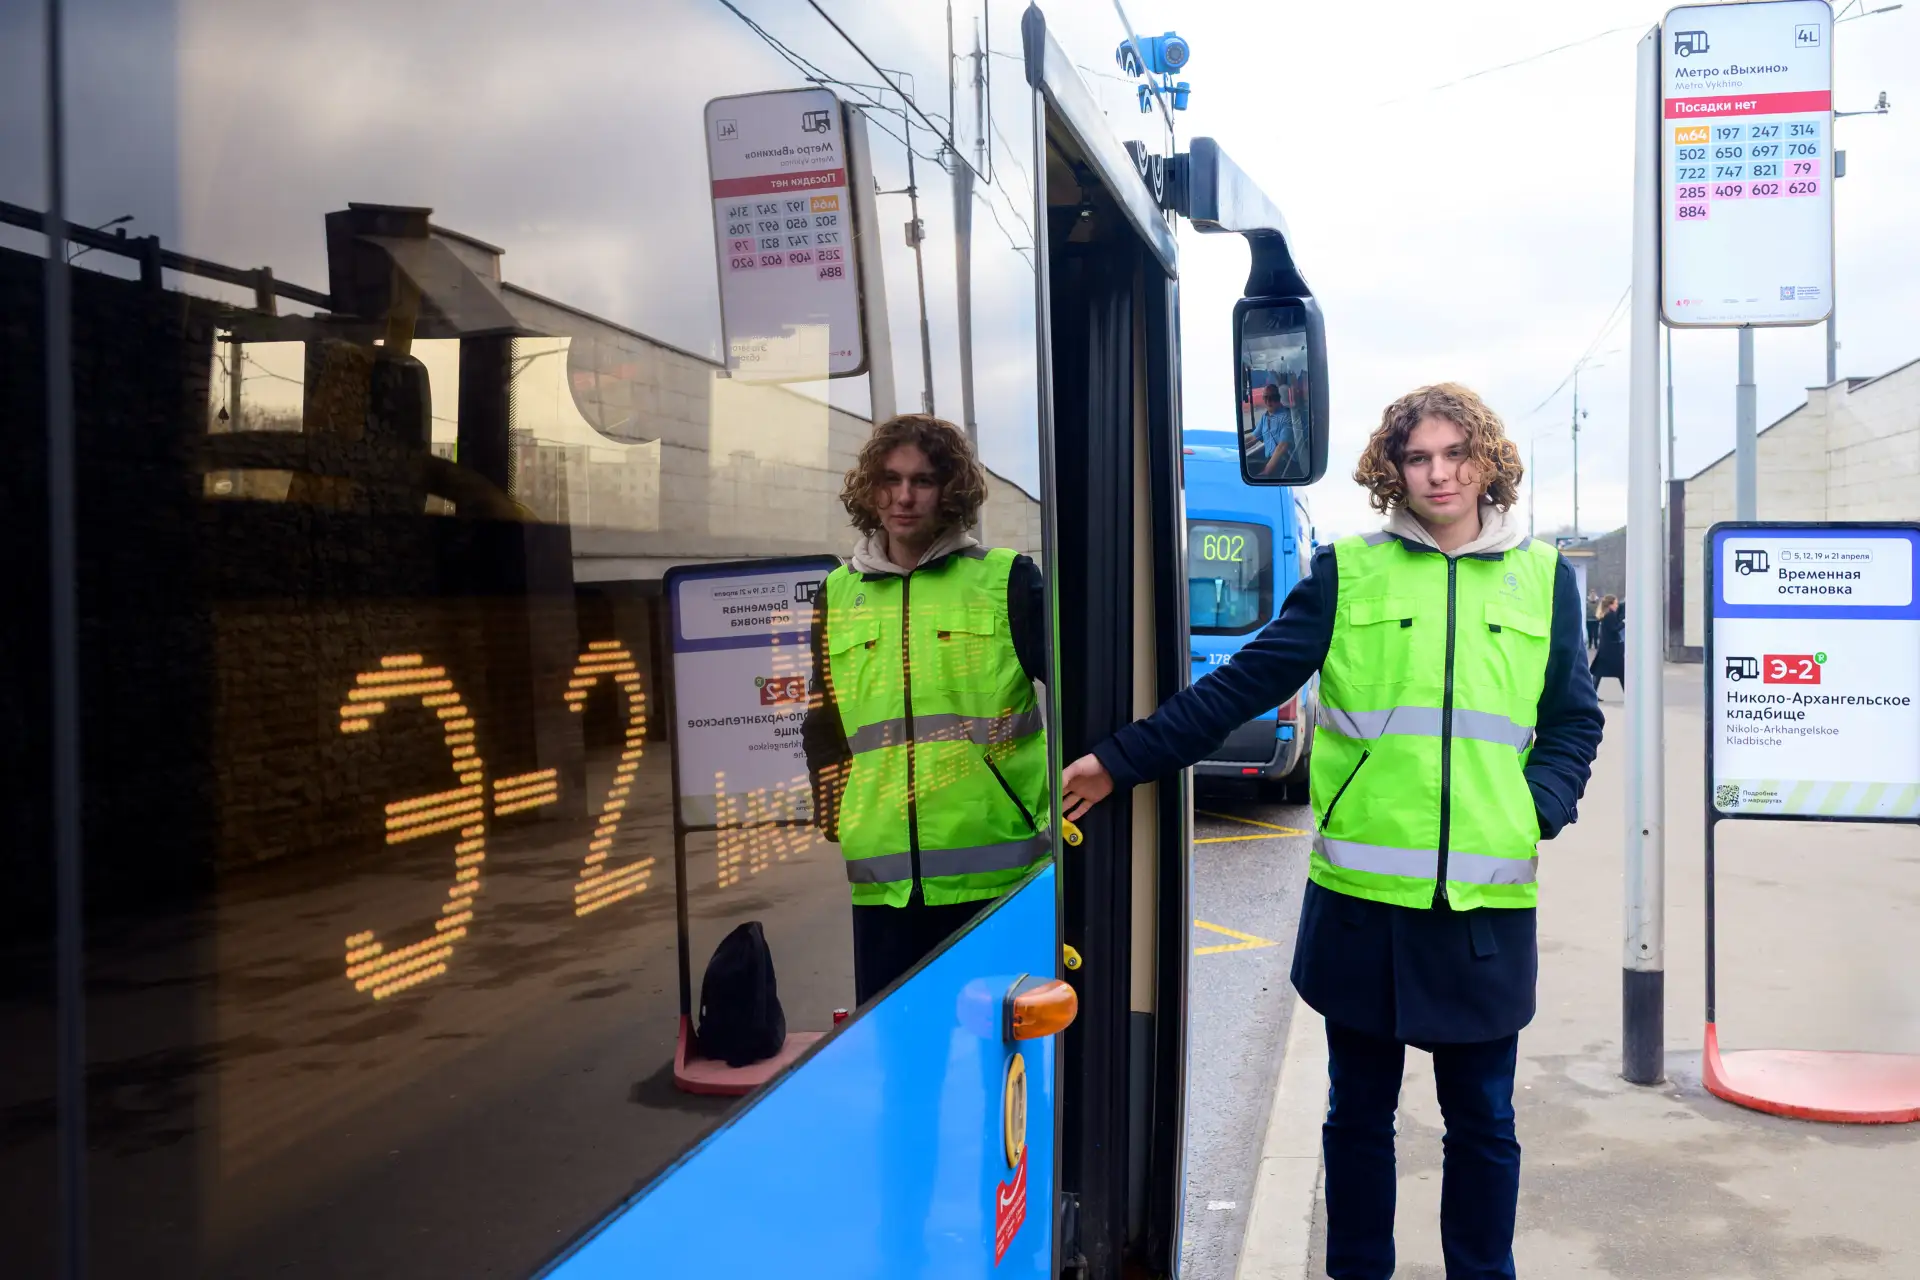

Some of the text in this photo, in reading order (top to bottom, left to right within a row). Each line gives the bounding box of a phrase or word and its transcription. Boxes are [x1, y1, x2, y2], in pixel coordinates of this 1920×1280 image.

[1797, 29, 1818, 42] 4L
[1675, 64, 1788, 78] Метро «Выхино»
[1675, 80, 1743, 90] Metro Vykhino
[1675, 100, 1757, 113] Посадки нет
[1677, 124, 1814, 141] м64 197 247 314
[1679, 143, 1817, 160] 502 650 697 706
[1679, 163, 1812, 179] 722 747 821 79
[1679, 181, 1817, 198] 285 409 602 620
[1679, 206, 1706, 218] 884
[1203, 535, 1245, 562] 602
[1794, 553, 1802, 561] 5,
[1803, 553, 1813, 561] 12,
[1778, 568, 1861, 581] Временная
[1778, 585, 1853, 595] остановка
[1770, 659, 1814, 680] Э-2
[1727, 691, 1911, 706] Николо-Архангельское
[1727, 708, 1806, 721] кладбище
[1726, 724, 1840, 736] Nikolo-Arkhangelskoe
[1726, 736, 1782, 746] Kladbische
[340, 639, 656, 1000] Э-2
